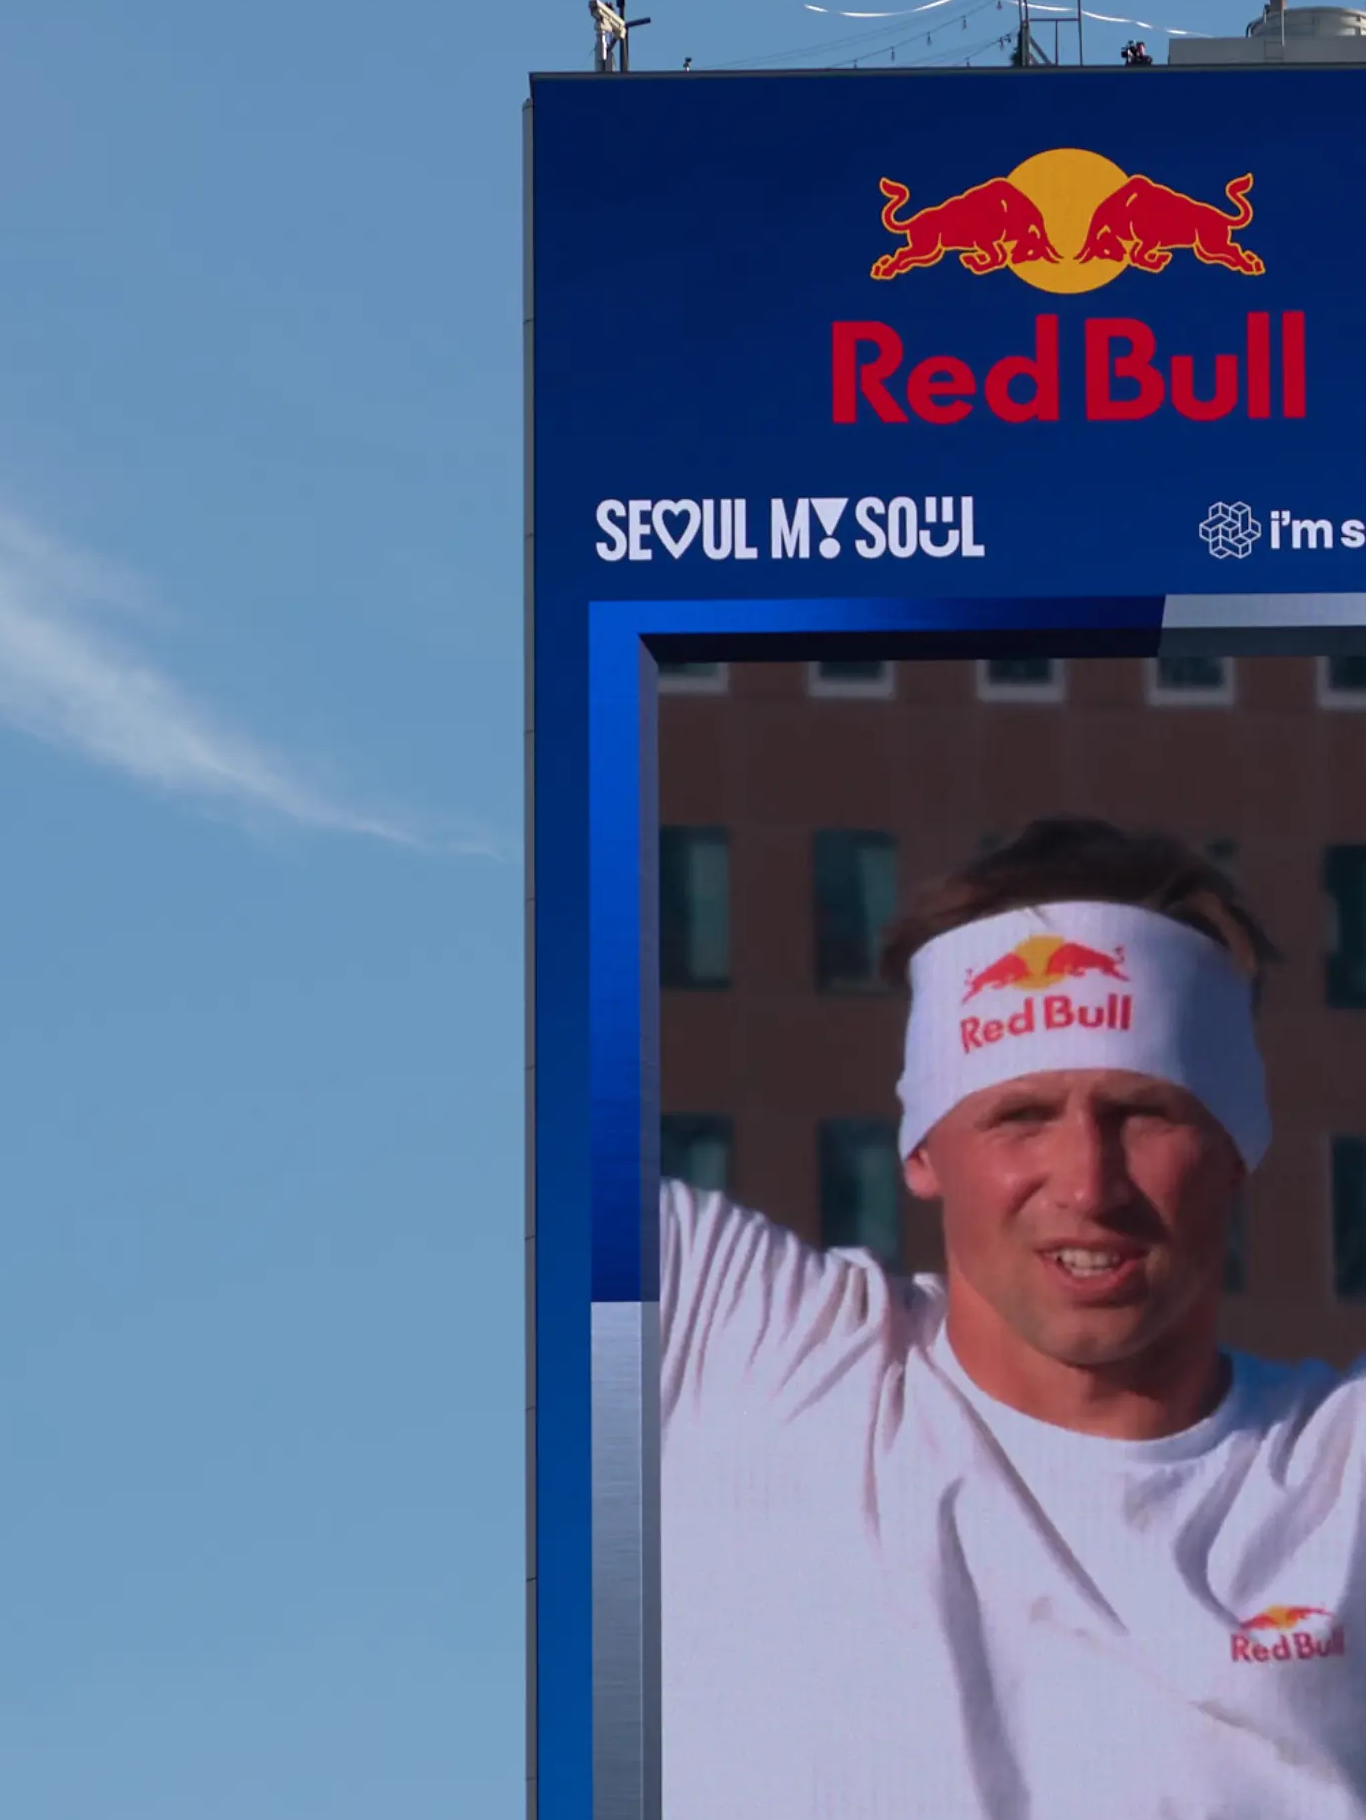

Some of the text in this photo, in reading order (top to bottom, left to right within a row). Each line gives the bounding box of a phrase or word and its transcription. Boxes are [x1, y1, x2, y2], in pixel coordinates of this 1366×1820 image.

[832, 311, 1305, 424] Red Bull
[596, 496, 757, 561] SEOUL
[855, 495, 984, 558] SOUL
[1270, 509, 1333, 549] i'm
[960, 993, 1132, 1055] Red Bull
[1231, 1625, 1345, 1663] Red Bull
